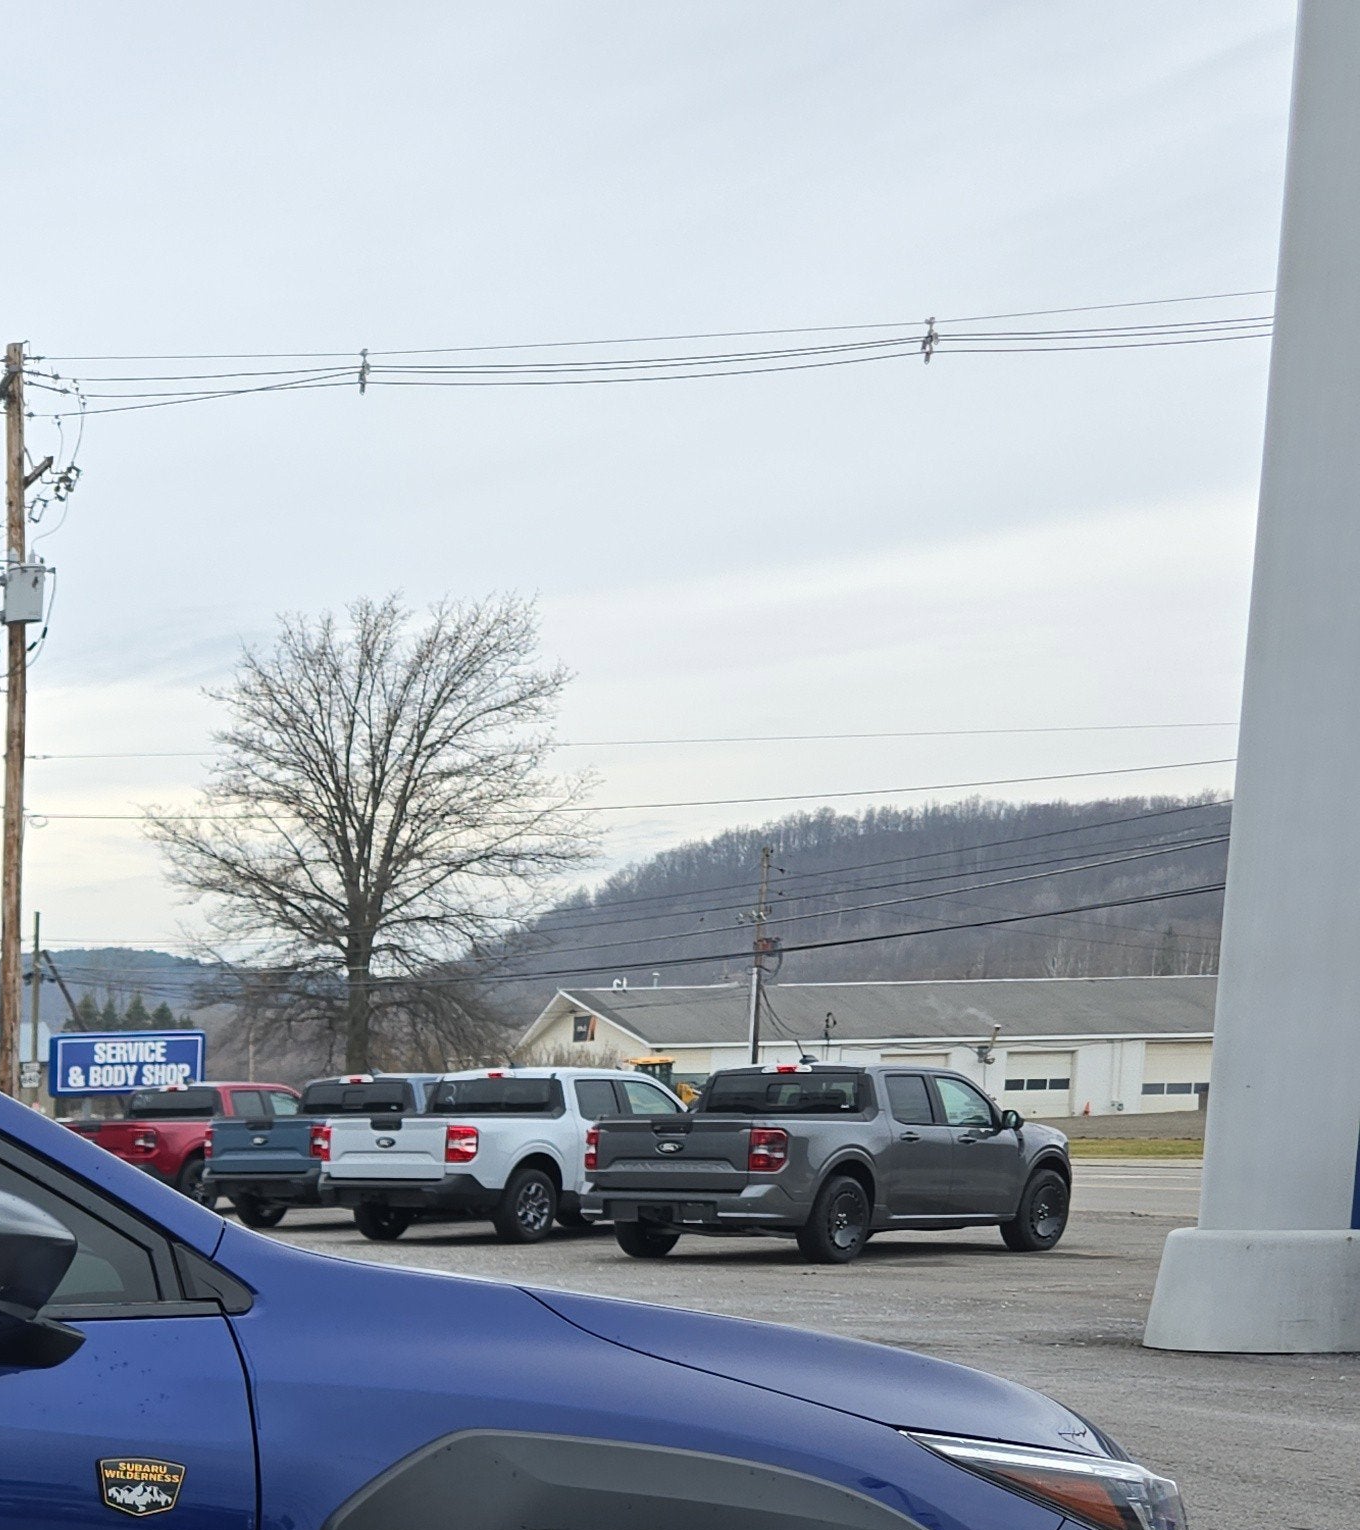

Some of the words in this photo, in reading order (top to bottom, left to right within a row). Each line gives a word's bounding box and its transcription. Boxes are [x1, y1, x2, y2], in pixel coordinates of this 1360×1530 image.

[93, 1041, 168, 1064] SERVICE
[67, 1065, 86, 1088] &
[89, 1064, 138, 1087] BODY
[142, 1062, 191, 1086] SHOP
[104, 1469, 180, 1483] WILDERNESS
[118, 1462, 168, 1474] SUBARU
